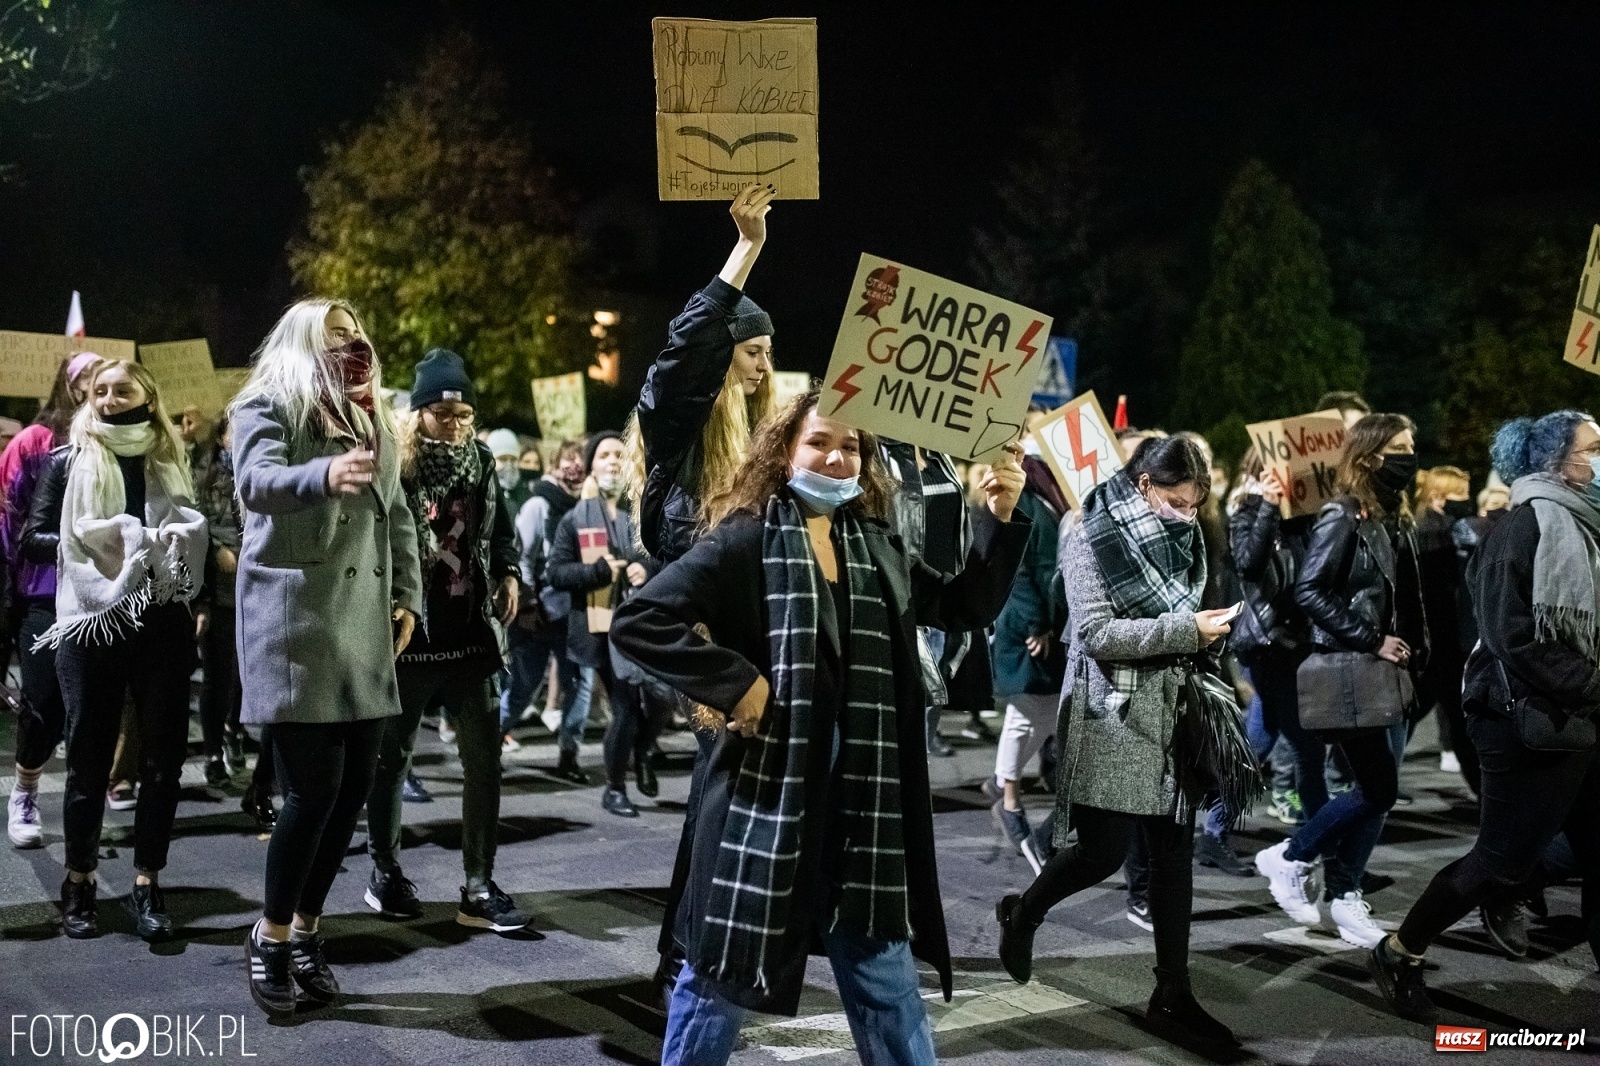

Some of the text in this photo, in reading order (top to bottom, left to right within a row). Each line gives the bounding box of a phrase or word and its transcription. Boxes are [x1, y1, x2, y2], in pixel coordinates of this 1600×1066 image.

[660, 25, 728, 87] Robimy
[735, 78, 815, 115] KOBIET
[666, 170, 753, 198] #Tojestwojn
[866, 277, 896, 296] STRAJK
[900, 286, 1011, 353] WARA
[866, 326, 1012, 399] GODEK
[873, 374, 974, 433] MNIE
